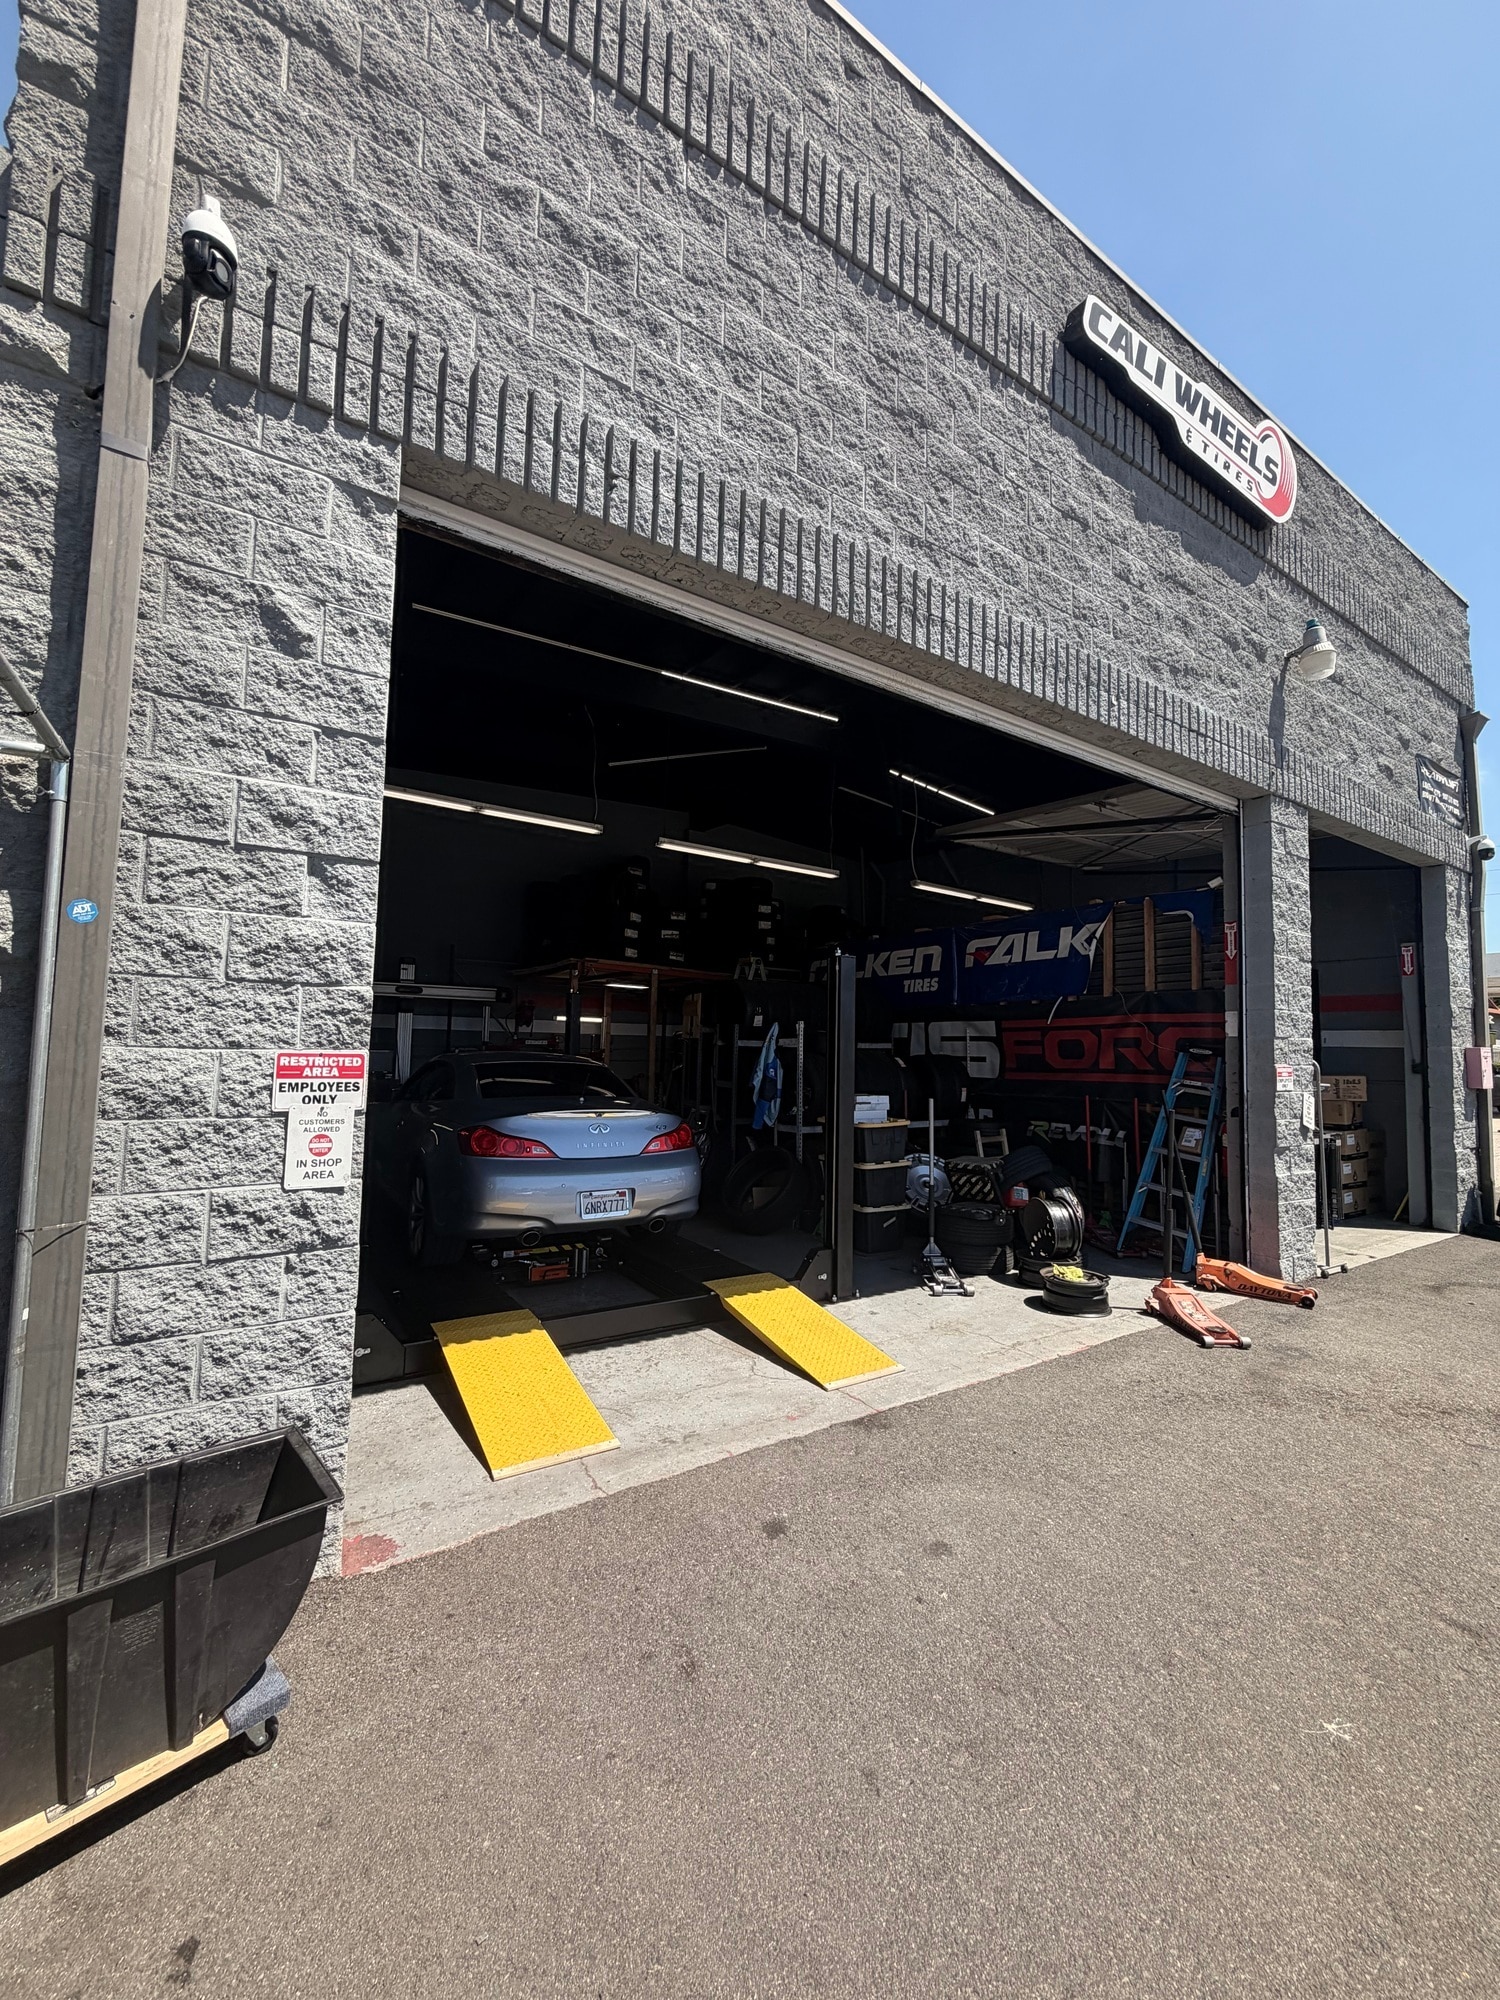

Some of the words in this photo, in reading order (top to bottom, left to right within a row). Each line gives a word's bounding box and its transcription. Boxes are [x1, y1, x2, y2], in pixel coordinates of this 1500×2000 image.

[1088, 301, 1166, 390] CALI
[1174, 370, 1279, 487] WHEELS
[1201, 439, 1253, 492] TIRES
[73, 903, 92, 914] ADT
[903, 977, 939, 994] TIRES
[279, 1056, 362, 1067] RESTRICTED
[302, 1067, 339, 1077] AREA
[278, 1081, 361, 1093] EMPLOYEES
[302, 1094, 338, 1105] ONLY
[576, 1141, 625, 1149] INFINITI
[296, 1159, 308, 1168] IN
[310, 1158, 343, 1168] SHOP
[303, 1170, 335, 1180] AREA
[585, 1198, 625, 1214] 6NRX777
[1236, 1283, 1292, 1300] DAYTONA
